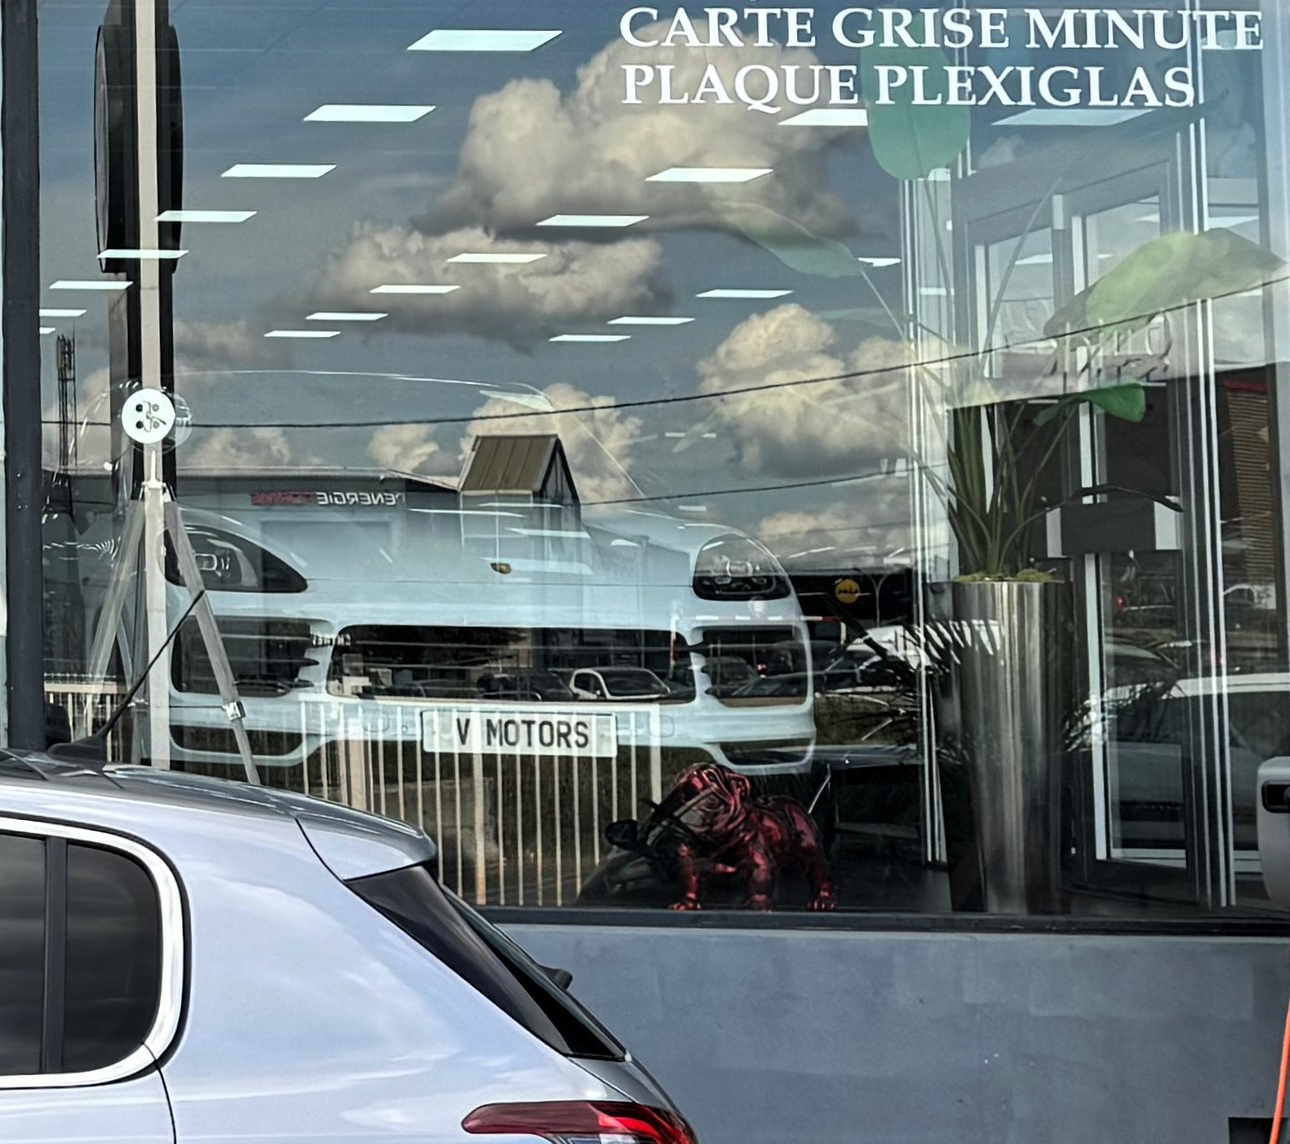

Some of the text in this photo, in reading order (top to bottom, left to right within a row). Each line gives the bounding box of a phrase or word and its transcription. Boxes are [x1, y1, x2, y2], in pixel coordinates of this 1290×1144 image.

[619, 7, 1264, 50] CARTE GRISE MINUTE
[620, 64, 1195, 114] PLAQUE PLEXIGLAS
[456, 717, 589, 749] V MOTORS
